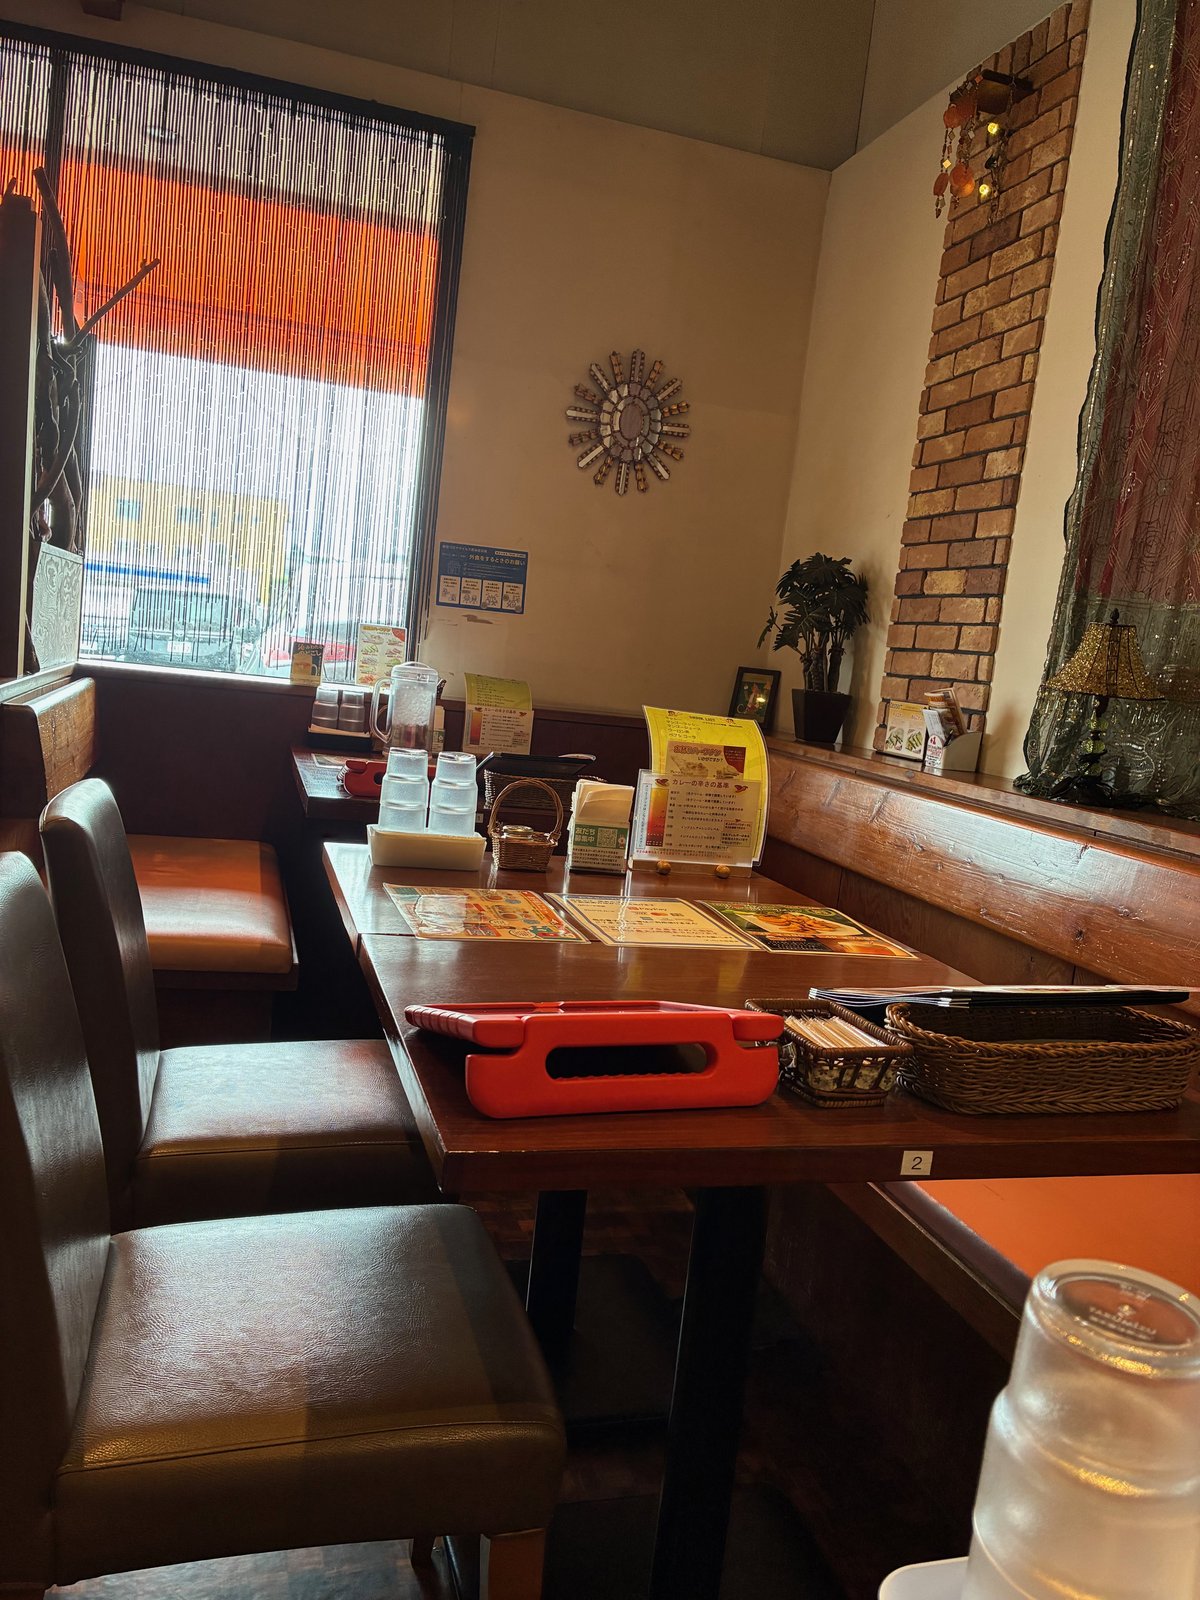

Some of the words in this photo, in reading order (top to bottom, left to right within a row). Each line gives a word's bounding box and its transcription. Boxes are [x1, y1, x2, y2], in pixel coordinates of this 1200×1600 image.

[672, 780, 730, 789] カレーの辛さの基準
[575, 827, 596, 835] 友だち
[911, 1156, 923, 1170] 2
